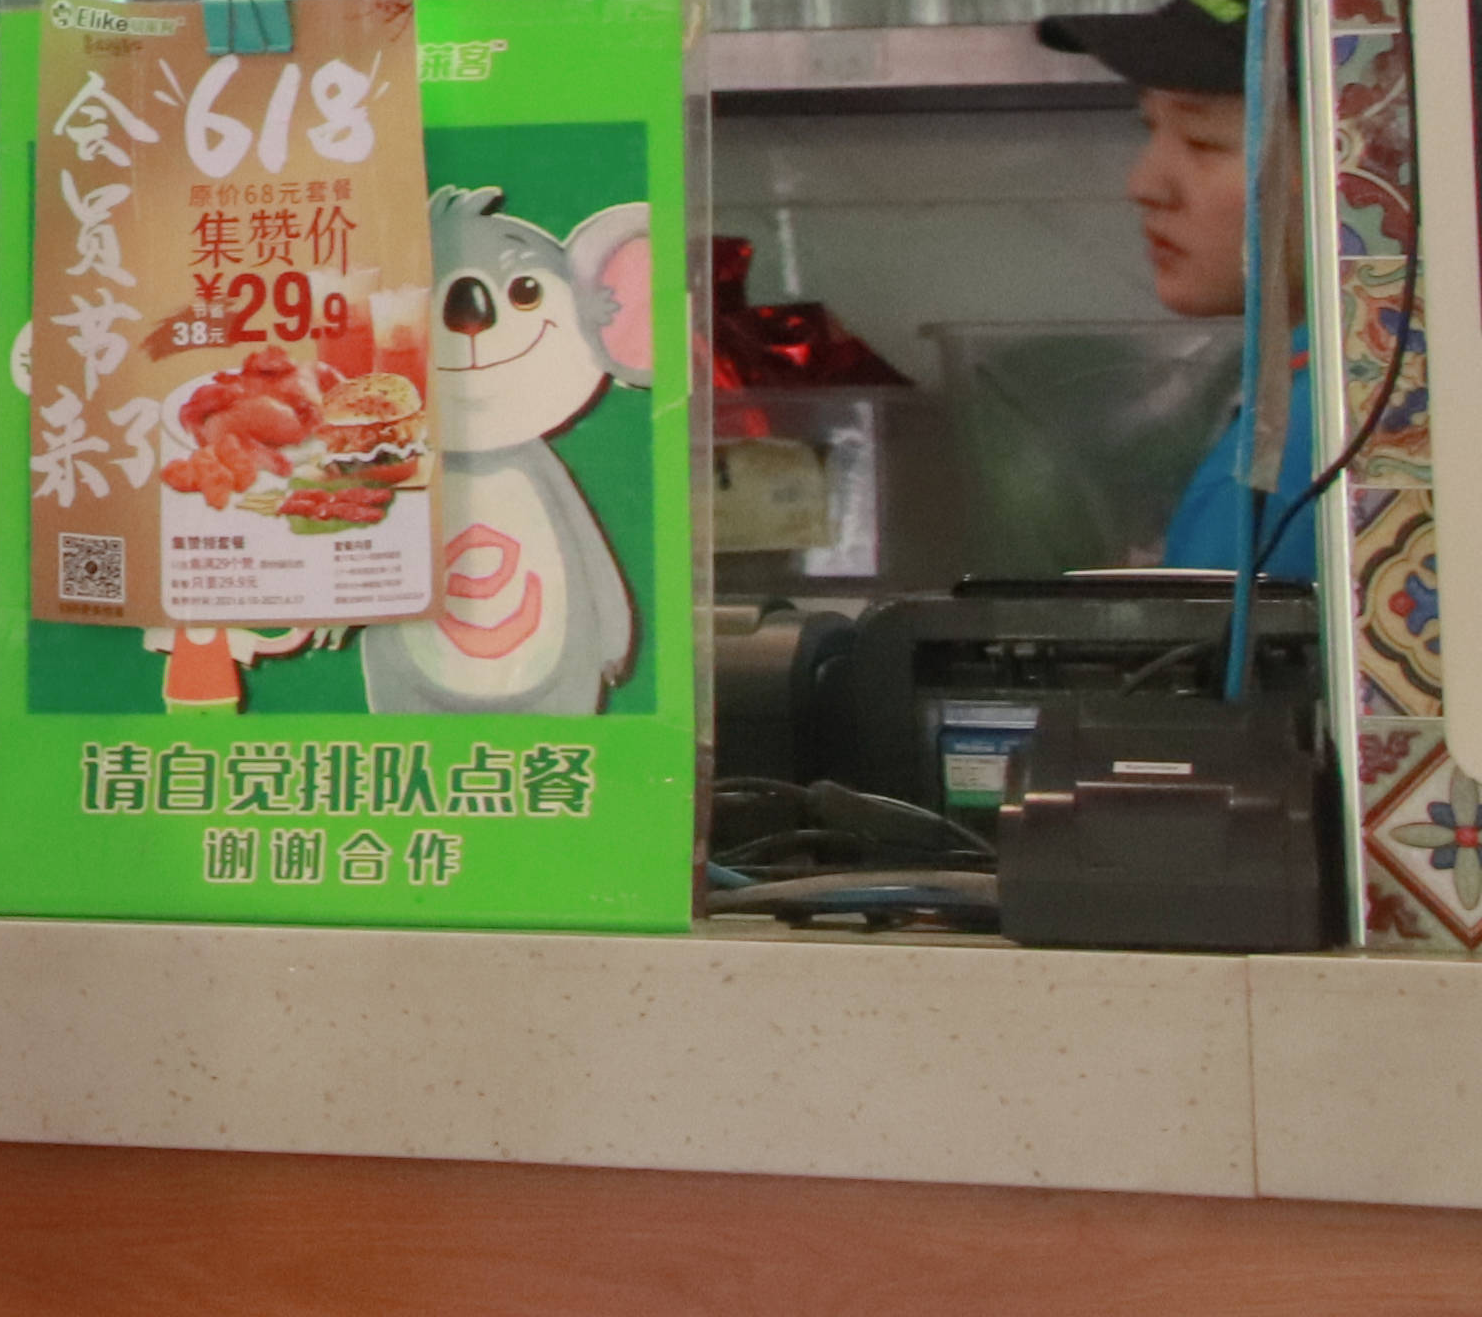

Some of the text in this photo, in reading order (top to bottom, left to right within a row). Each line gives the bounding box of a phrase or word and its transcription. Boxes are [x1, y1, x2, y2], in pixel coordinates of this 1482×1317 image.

[184, 55, 375, 179] 618
[188, 177, 353, 207] 原价68元套餐
[190, 206, 357, 277] 集赞价
[81, 741, 596, 817] 请自觉排队点餐
[203, 826, 464, 886] 谢谢合作
